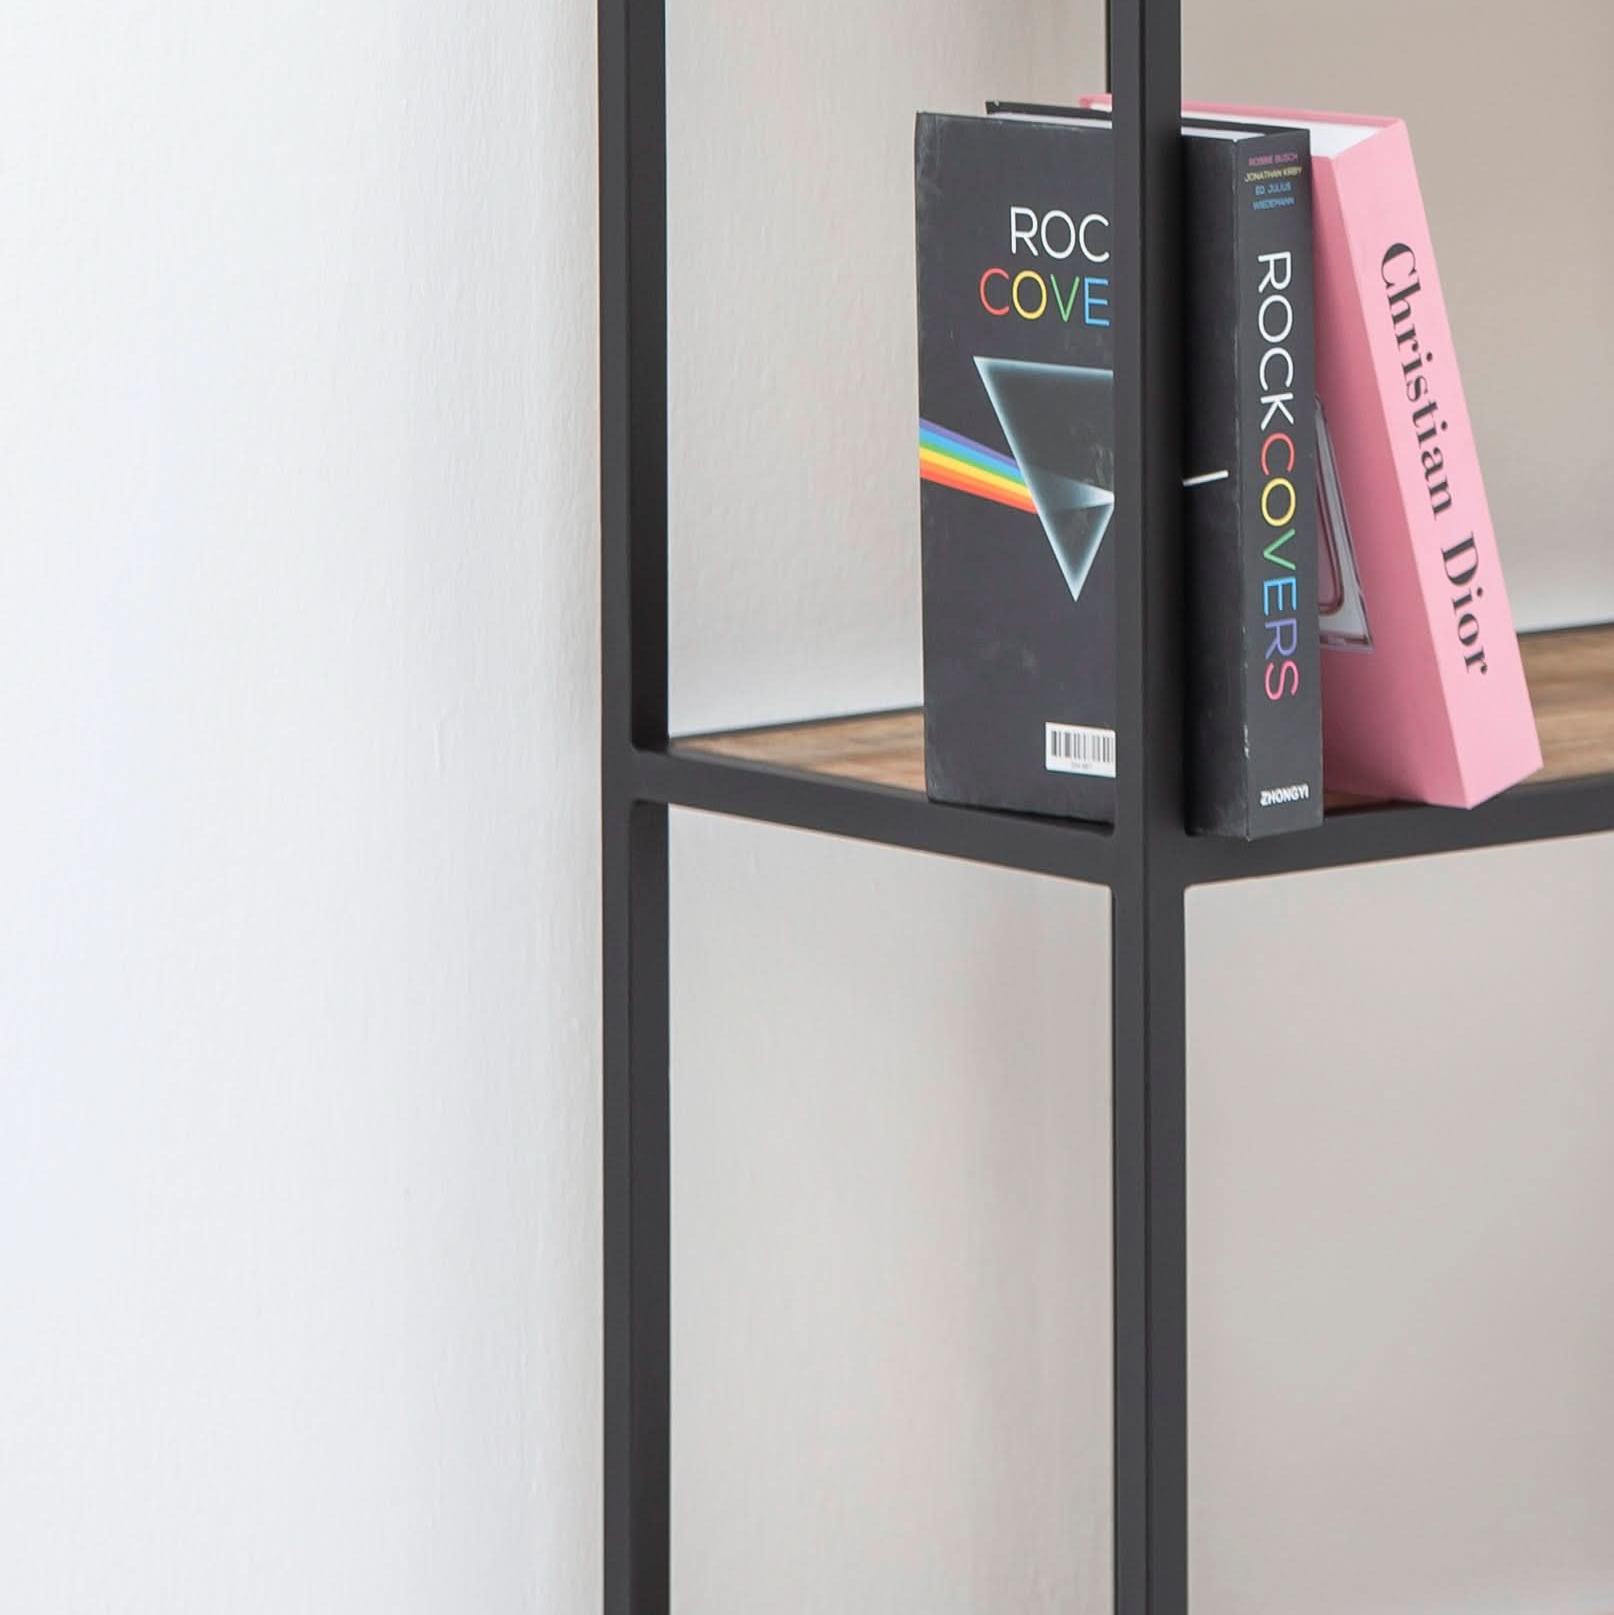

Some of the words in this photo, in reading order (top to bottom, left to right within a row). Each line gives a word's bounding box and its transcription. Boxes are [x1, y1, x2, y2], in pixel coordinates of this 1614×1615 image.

[1010, 206, 1110, 263] ROC
[979, 267, 1110, 327] COVE
[1381, 242, 1454, 520] Christian
[1441, 530, 1488, 675] Dior
[1260, 783, 1309, 806] ZHONGYI
